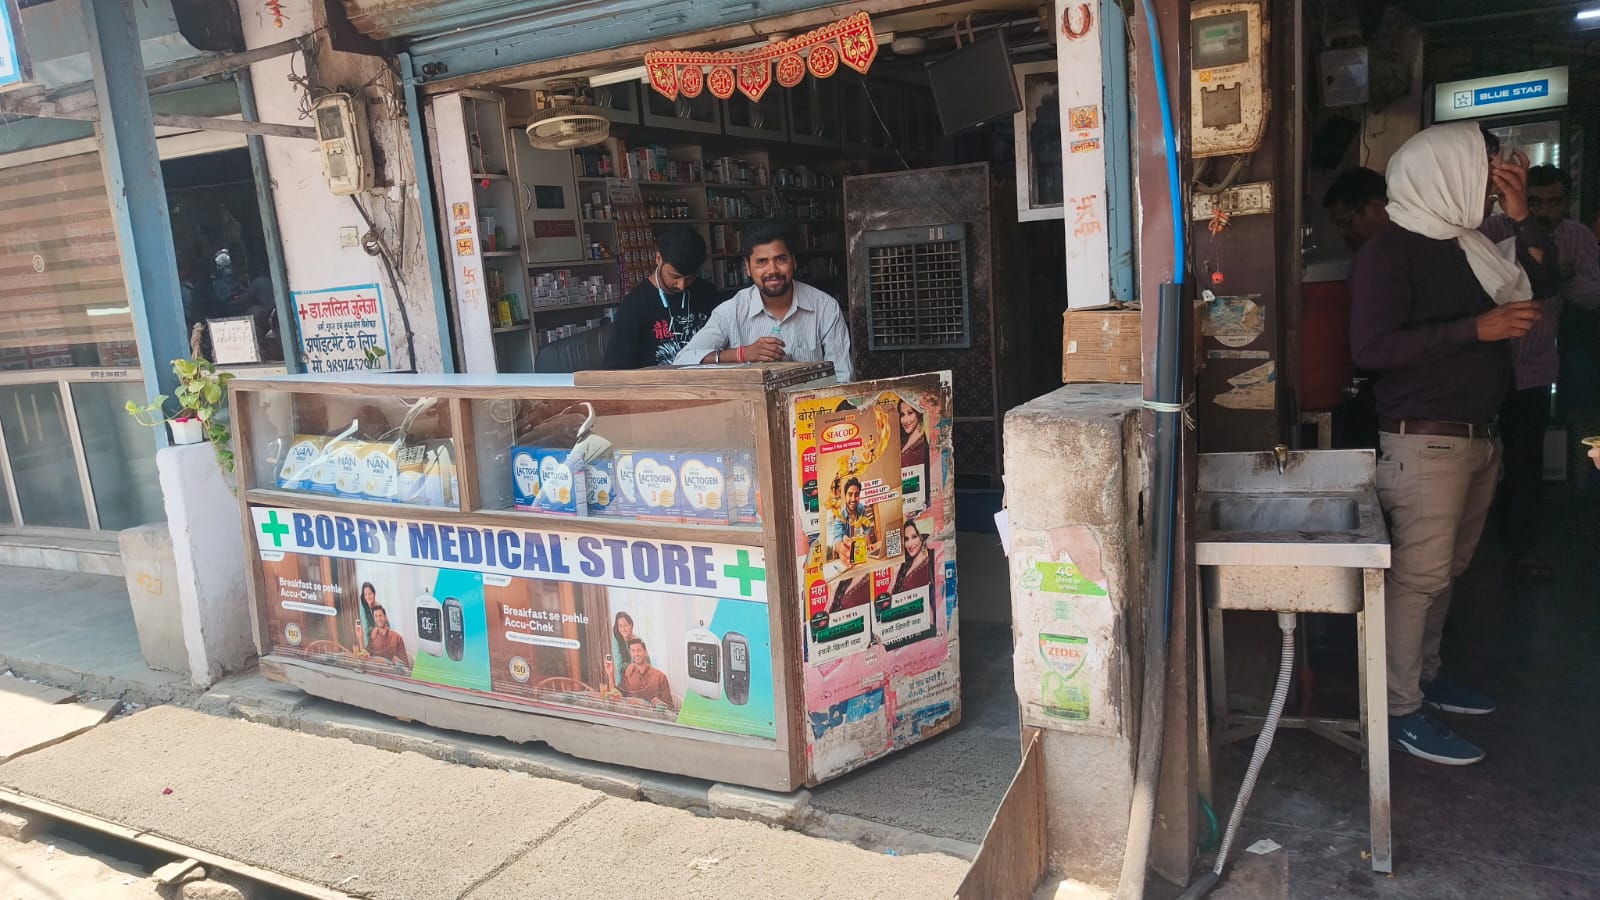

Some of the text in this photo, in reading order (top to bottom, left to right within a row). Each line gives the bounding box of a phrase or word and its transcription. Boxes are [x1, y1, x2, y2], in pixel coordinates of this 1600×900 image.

[1480, 85, 1542, 100] BLUE STAR
[350, 294, 377, 319] जुनेजा
[345, 332, 356, 351] के
[357, 331, 378, 350] लिए
[826, 428, 853, 440] SEACOD
[293, 447, 314, 457] NAN
[338, 455, 356, 466] NAN
[366, 458, 389, 469] NAN
[542, 470, 568, 481] LACTOGEN
[639, 472, 671, 484] LACTOGEN
[684, 476, 718, 488] LACTOGEN
[651, 490, 657, 502] 3
[697, 492, 703, 505] 3
[292, 512, 717, 589] BOBBY MEDICAL STORE
[279, 577, 312, 590] Breakfast
[322, 584, 343, 594] pehle
[875, 577, 890, 587] बचत
[280, 588, 317, 600] Accu-Chek
[811, 584, 826, 597] महा
[811, 595, 827, 605] बचत
[503, 605, 589, 624] Breakfast se pehle
[504, 617, 554, 632] Accu-Chek
[1048, 647, 1081, 658] ZEDEX
[513, 664, 526, 674] ISO
